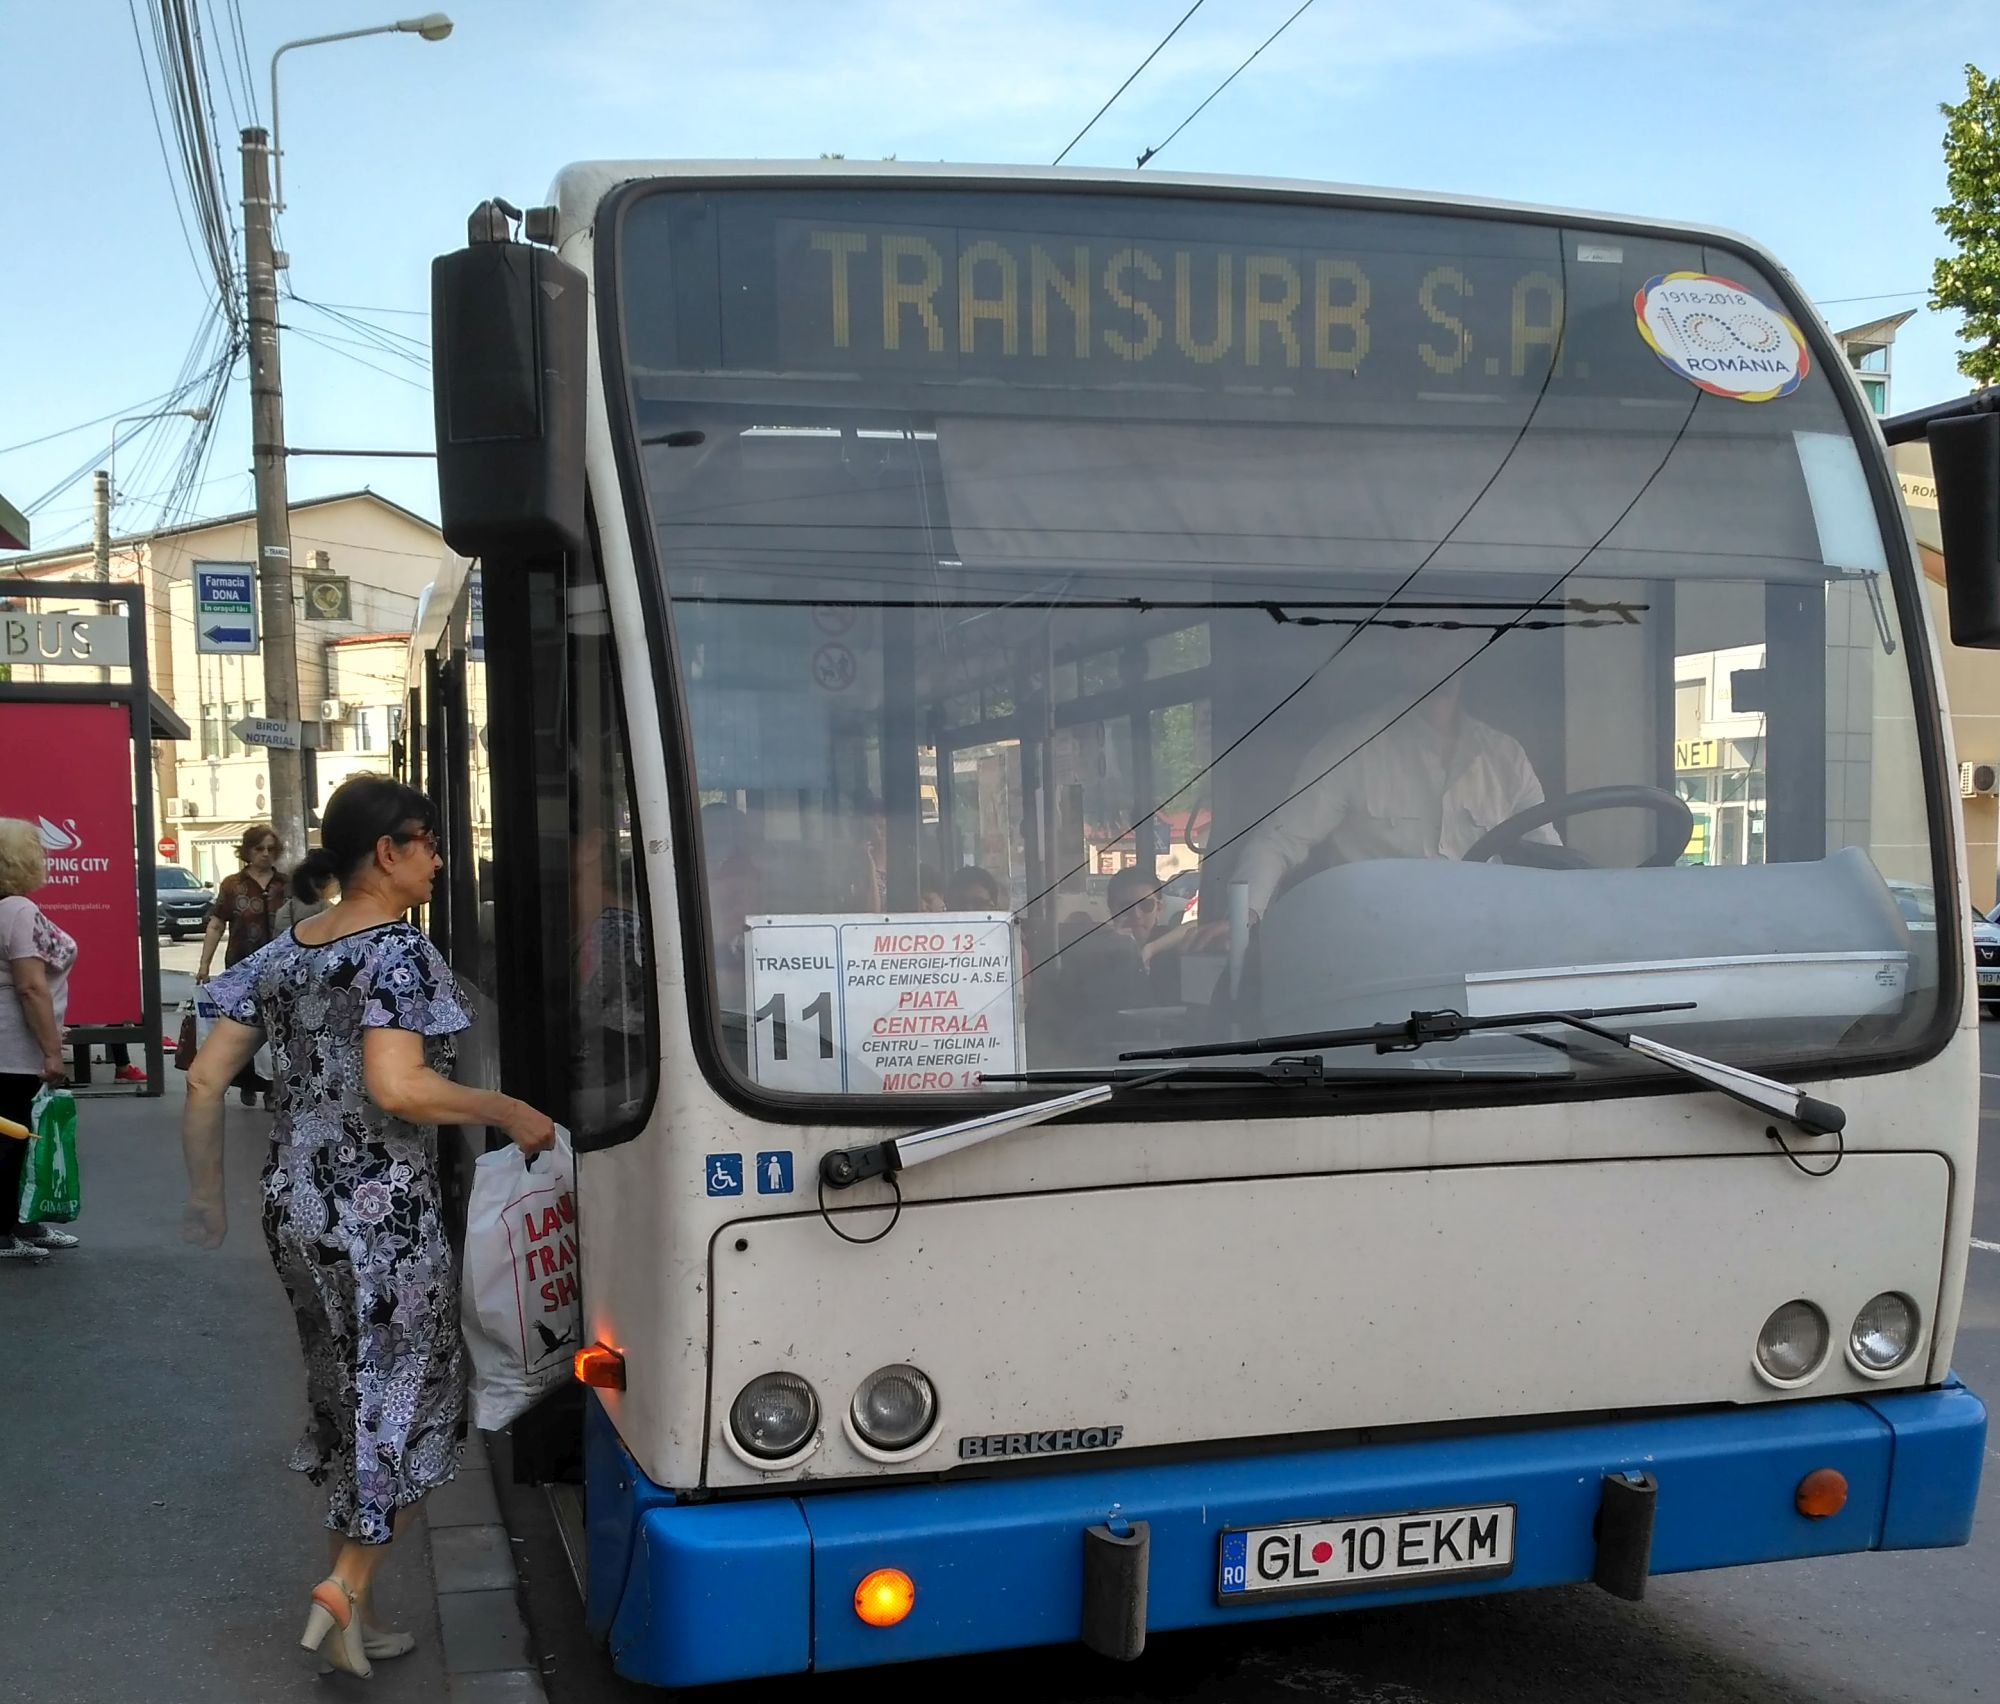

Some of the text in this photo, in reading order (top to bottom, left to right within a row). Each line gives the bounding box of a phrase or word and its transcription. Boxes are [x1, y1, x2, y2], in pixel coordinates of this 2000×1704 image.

[811, 231, 1371, 372] TRANSURB
[1660, 290, 1747, 306] 1918-2018
[1686, 355, 1790, 373] ROMÂNIA
[205, 575, 245, 588] Farmacia
[212, 589, 240, 601] DONA
[6, 620, 92, 659] BUS
[256, 721, 287, 732] BIROU
[246, 733, 296, 746] NOTARIAL
[1676, 740, 1713, 767] NET
[81, 857, 109, 872] CITY
[45, 875, 80, 887] ALAȚI
[873, 935, 945, 953] MICRO
[951, 934, 975, 951] 13
[756, 956, 835, 971] TRASEUL
[846, 959, 877, 971] P-TA
[879, 957, 1002, 970] ENERGIEI-TIGLINA
[848, 974, 885, 987] PARC
[889, 973, 960, 986] EMINESCU
[970, 971, 1008, 984] A.S.E.
[899, 990, 959, 1009] PIATA
[756, 992, 834, 1061] 11
[872, 1014, 989, 1035] CENTRALA
[862, 1039, 918, 1053] CENTRU
[933, 1038, 986, 1050] TIGLINA
[875, 1056, 914, 1068] PIATA
[916, 1054, 982, 1067] ENERGIEI
[882, 1072, 953, 1091] MICRO
[958, 1425, 1124, 1460] BERKHOF
[1223, 1513, 1500, 1586] RO GL 10 EKM
